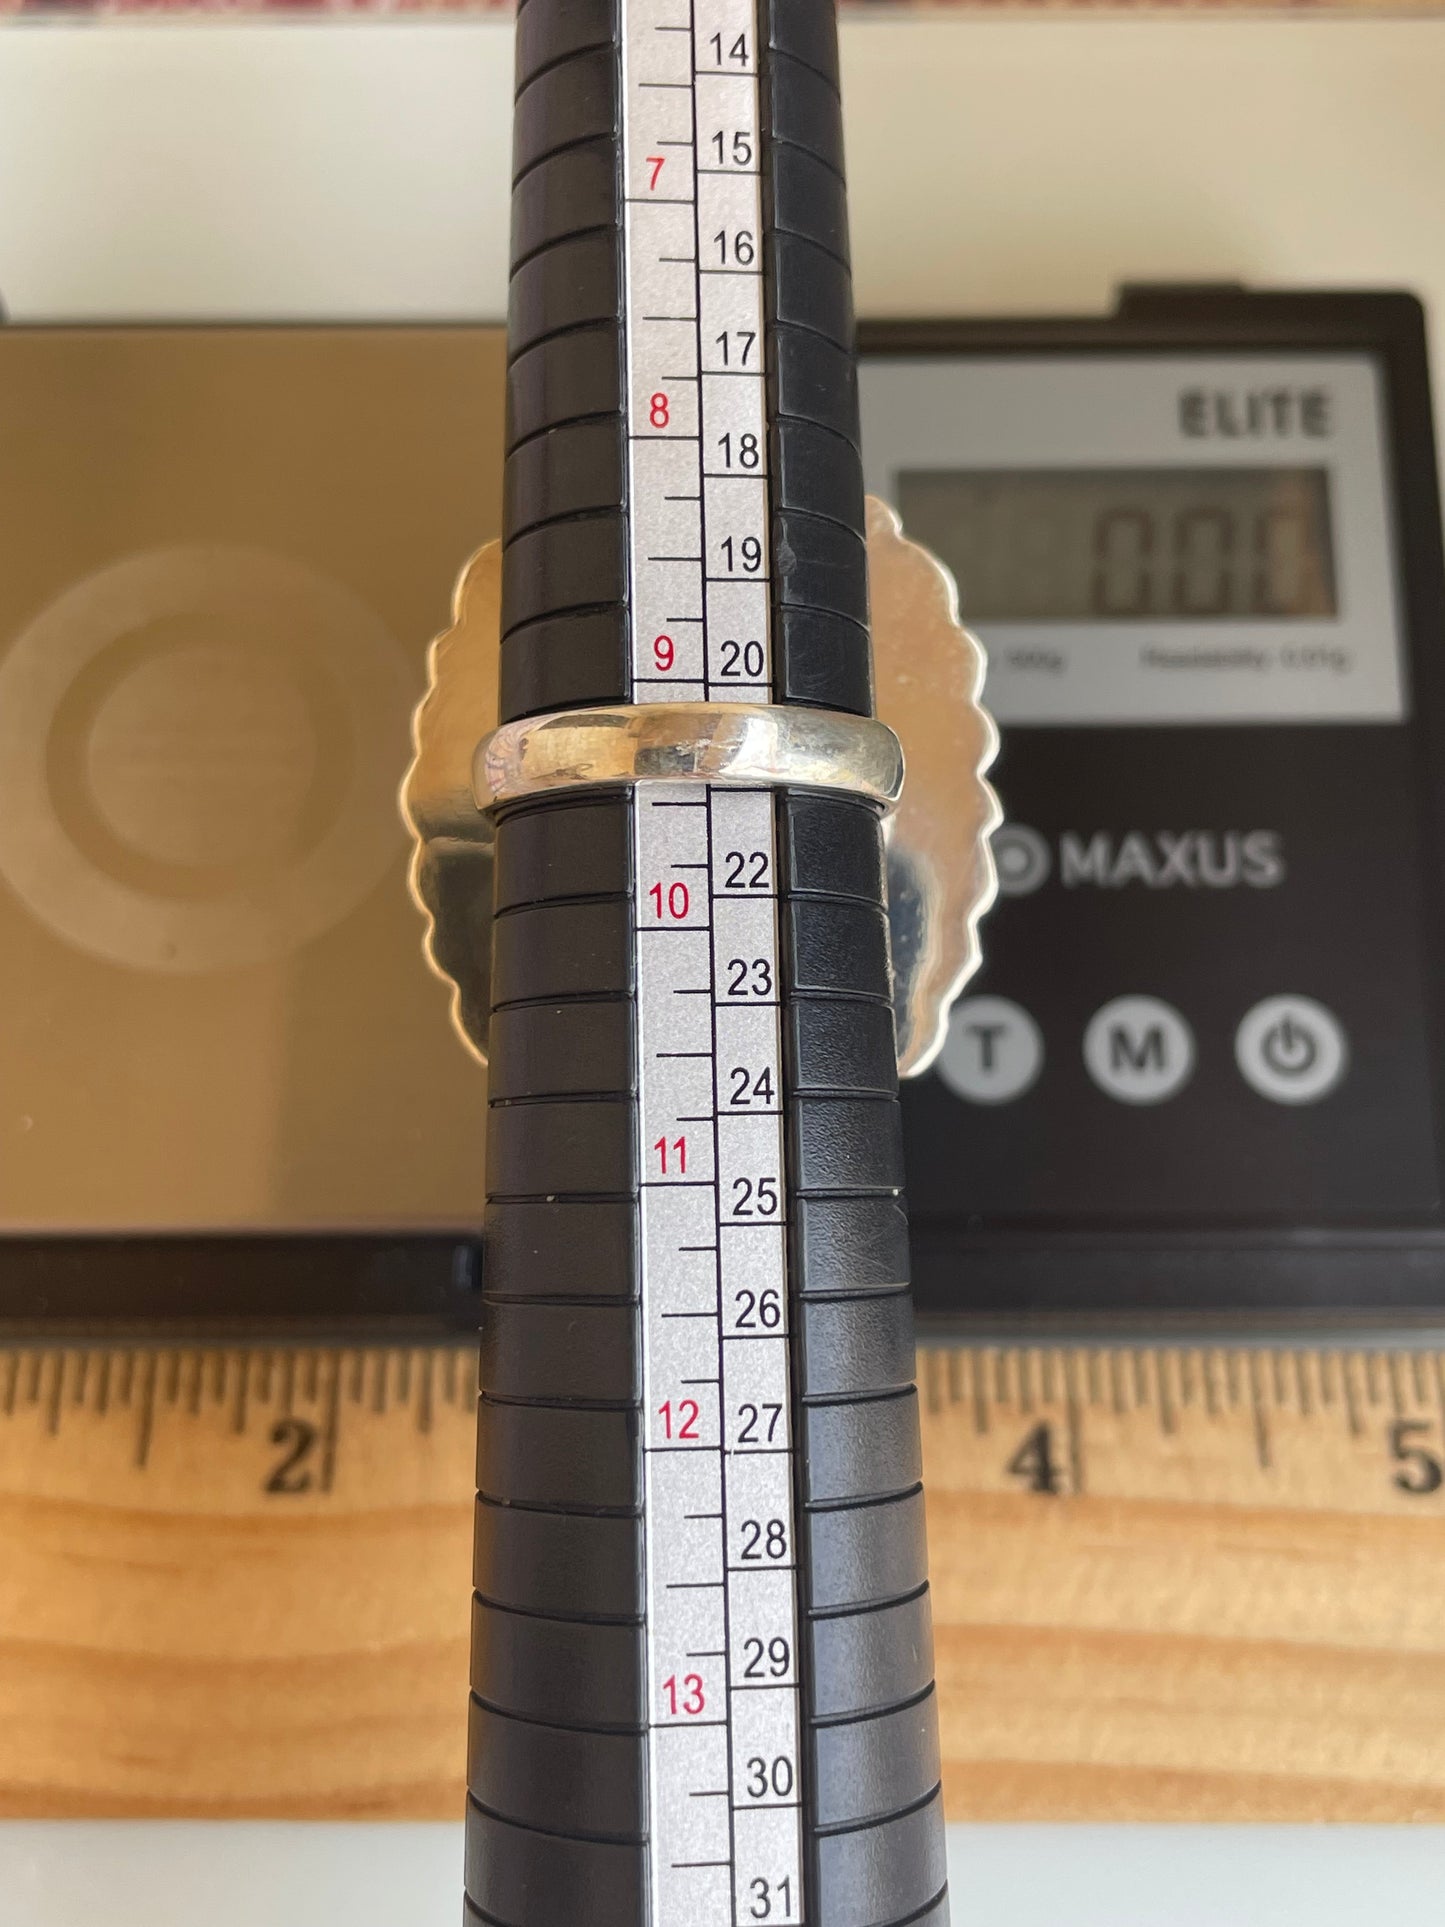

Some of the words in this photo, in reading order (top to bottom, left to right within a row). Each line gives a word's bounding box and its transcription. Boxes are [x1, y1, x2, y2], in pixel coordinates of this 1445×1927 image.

[710, 32, 749, 67] 14
[712, 130, 752, 165] 15
[646, 157, 665, 190] 7
[713, 230, 755, 266] 16
[716, 330, 756, 366] 17
[649, 392, 670, 429] 8
[1180, 389, 1334, 437] ELITE
[718, 432, 759, 469] 18
[720, 535, 762, 573] 19
[653, 634, 675, 672] 9
[720, 640, 765, 678] 20
[724, 851, 770, 889] 22
[1061, 831, 1285, 887] MAXUS
[649, 881, 690, 920] 10
[727, 958, 773, 996] 23
[968, 1023, 1006, 1073] T
[1109, 1027, 1167, 1073] M
[730, 1066, 775, 1106] 24
[654, 1136, 687, 1174] 11
[732, 1177, 778, 1216] 25
[735, 1289, 781, 1328] 26
[658, 1399, 699, 1439] 12
[737, 1403, 783, 1444] 27
[265, 1419, 317, 1494] 2
[1007, 1422, 1061, 1494] 4
[1390, 1421, 1442, 1493] 5
[741, 1519, 787, 1560] 28
[743, 1636, 790, 1678] 29
[663, 1674, 705, 1715] 13
[747, 1756, 793, 1798] 30
[750, 1875, 791, 1919] 31
